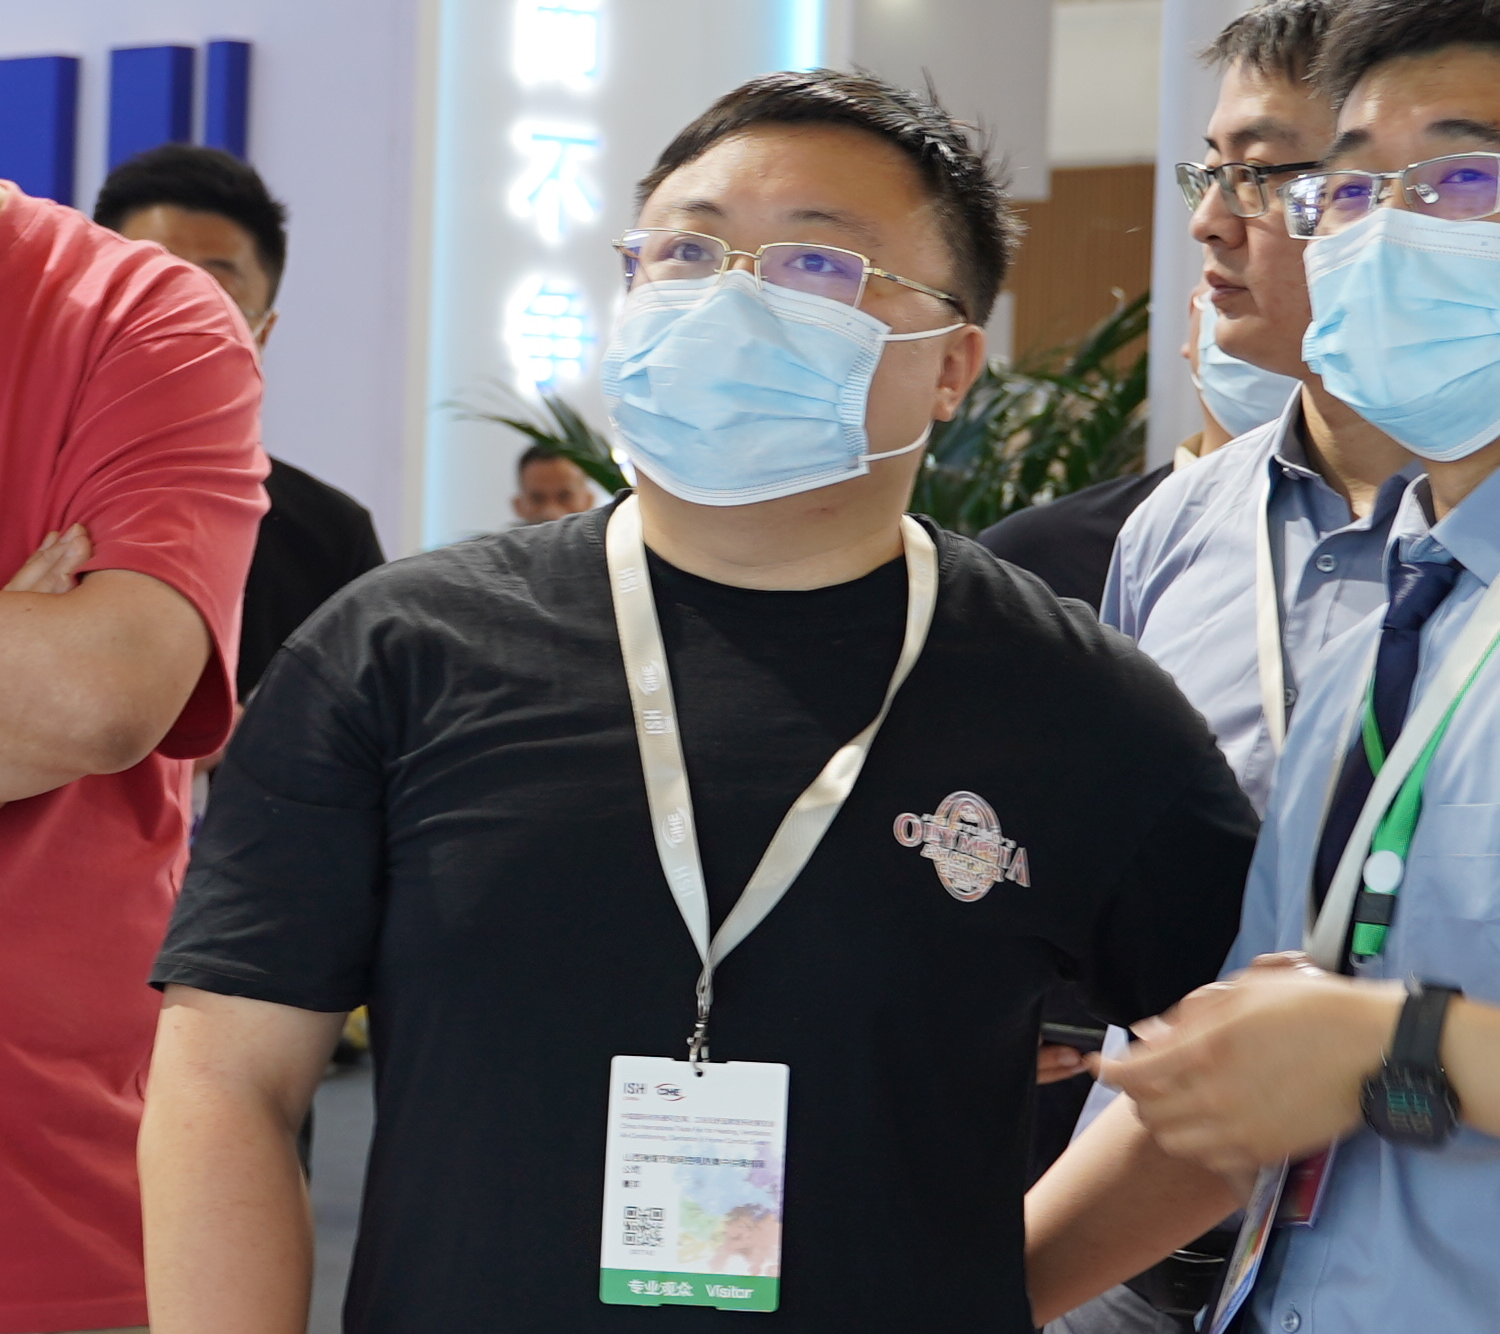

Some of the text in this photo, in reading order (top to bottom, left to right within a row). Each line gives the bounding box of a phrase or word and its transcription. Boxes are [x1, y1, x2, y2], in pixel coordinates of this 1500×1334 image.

[627, 1279, 754, 1299] 专业观众 Visitor
